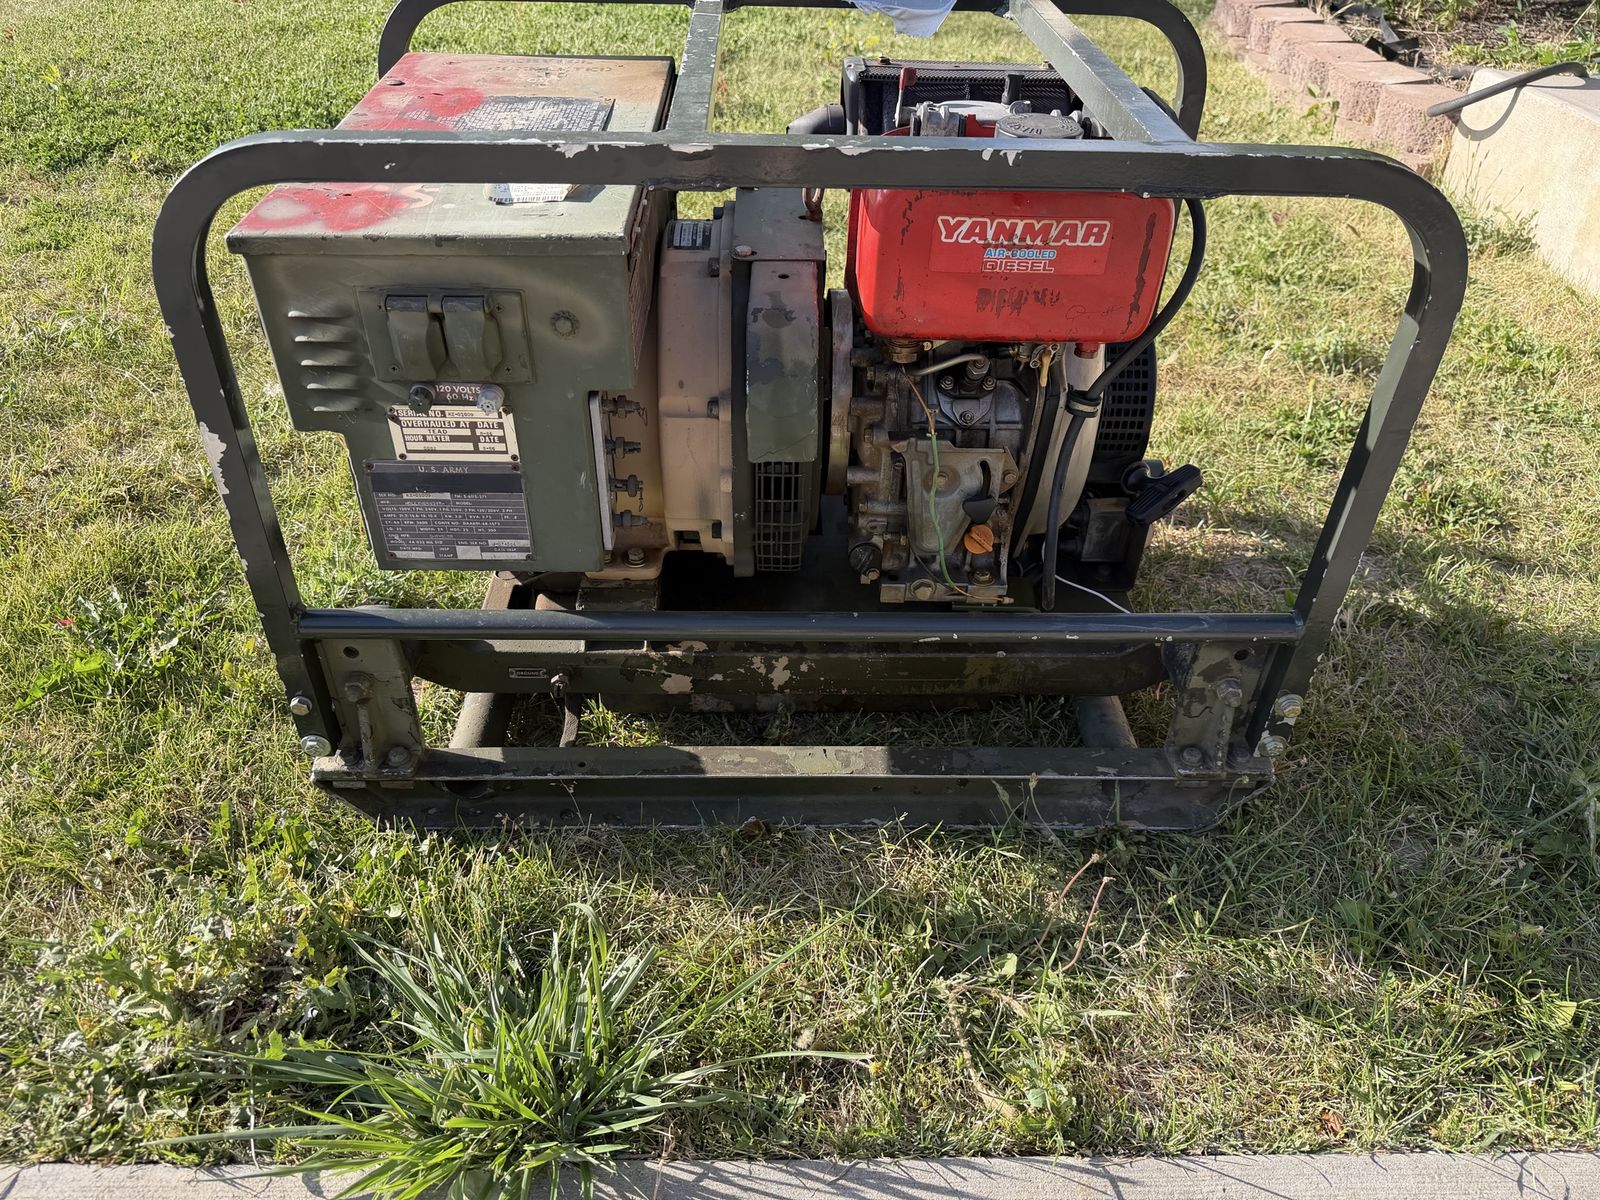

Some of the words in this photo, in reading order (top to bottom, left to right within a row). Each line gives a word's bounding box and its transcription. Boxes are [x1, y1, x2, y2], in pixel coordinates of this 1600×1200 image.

[937, 216, 1111, 246] YANMAR
[984, 248, 1057, 259] AIR-COOLED
[982, 259, 1054, 273] DIESEL
[436, 384, 451, 393] 120
[453, 385, 480, 394] VOLTS
[401, 420, 456, 428] OVERHAULED
[460, 420, 470, 428] AT
[477, 421, 498, 429] DATE
